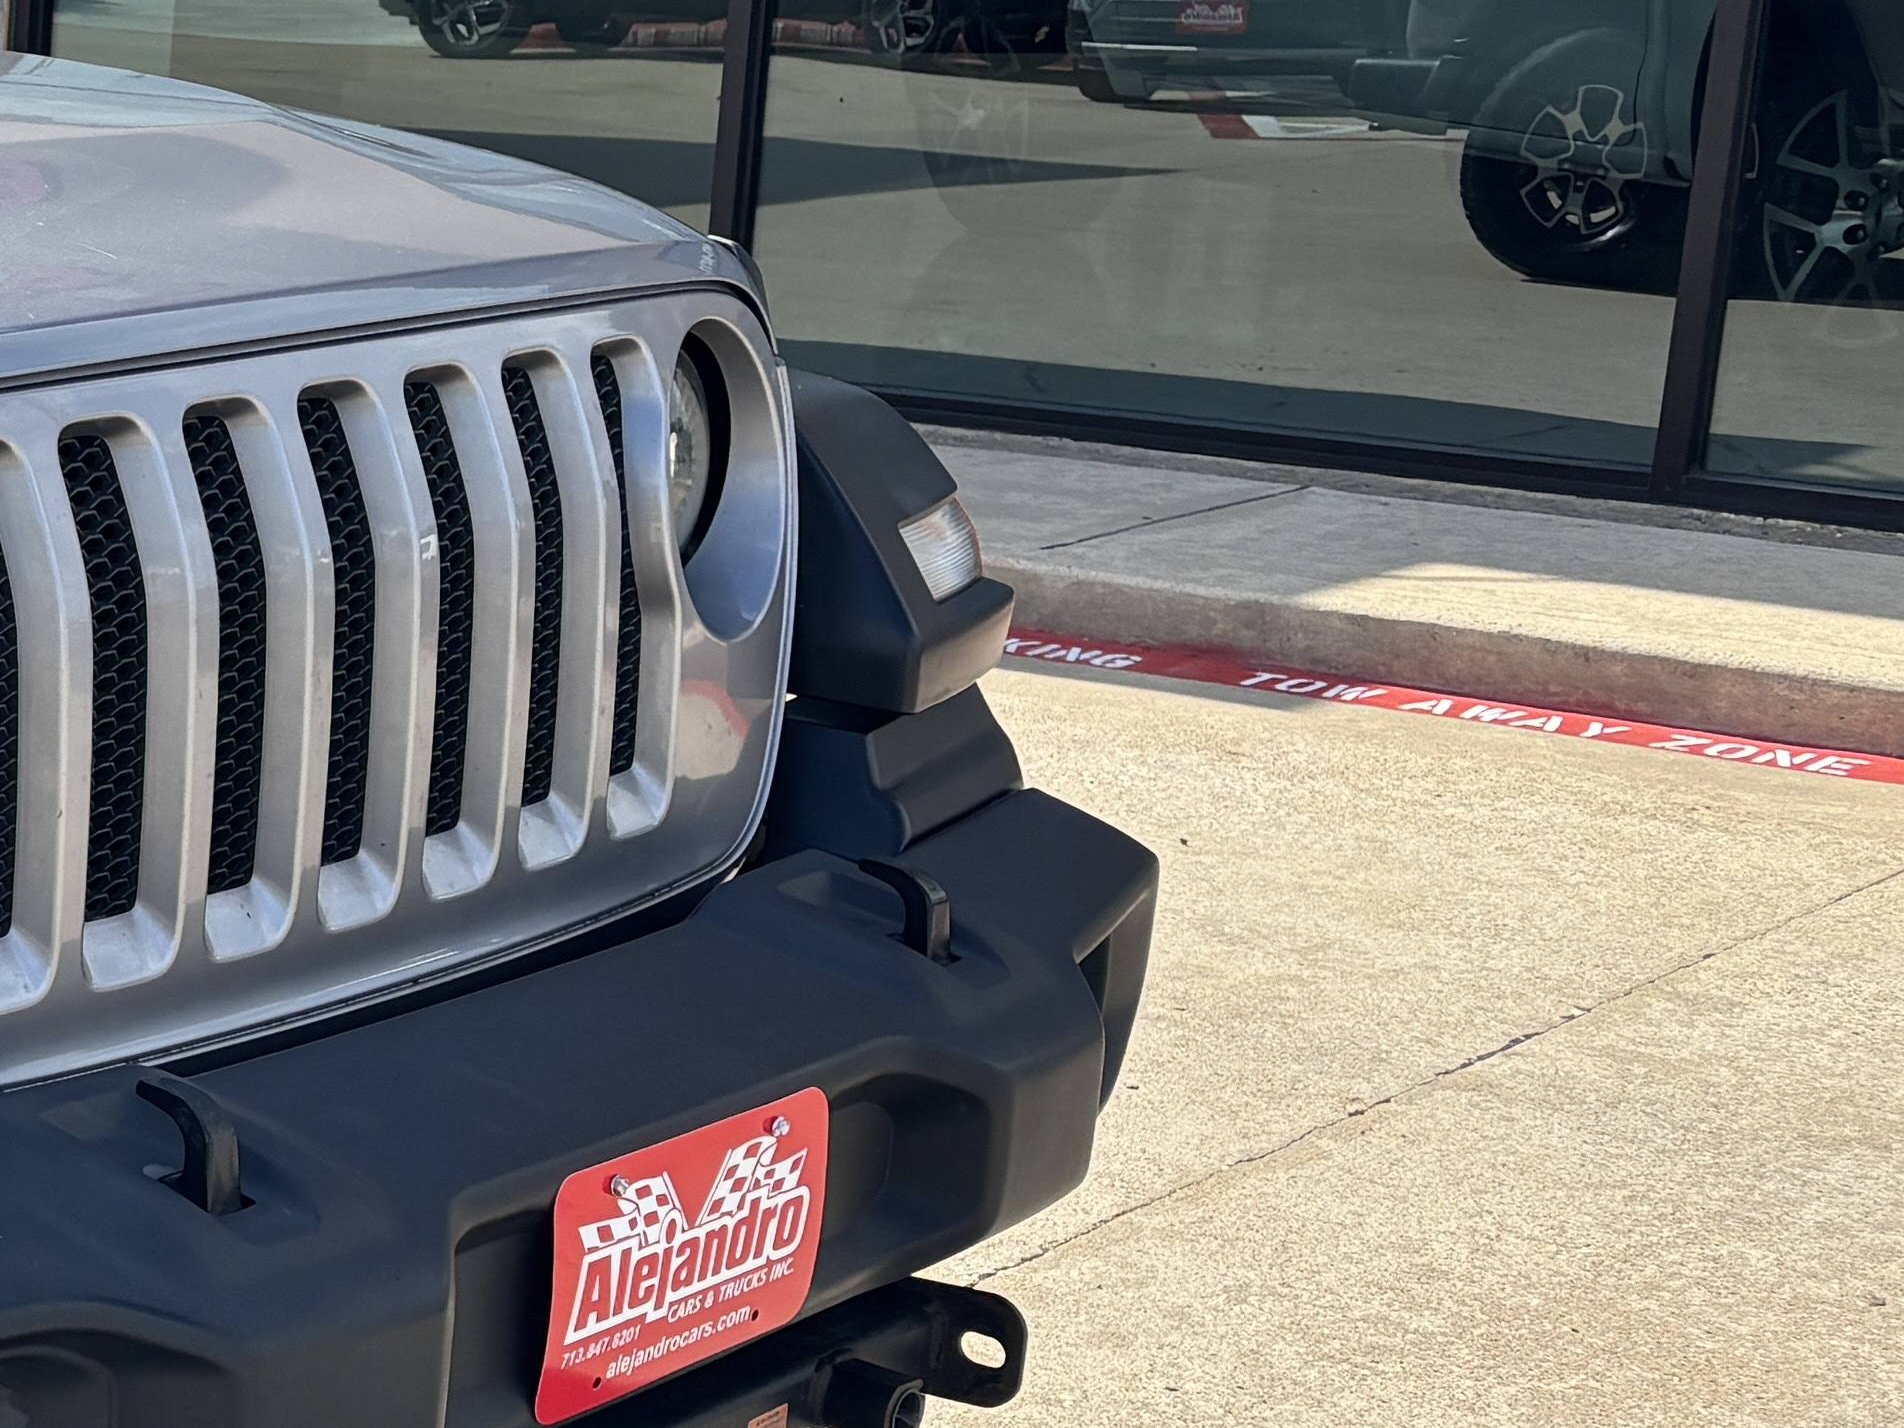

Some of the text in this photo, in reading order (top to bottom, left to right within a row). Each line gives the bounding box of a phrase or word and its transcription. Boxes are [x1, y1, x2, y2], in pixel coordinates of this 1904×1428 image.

[1237, 671, 1874, 778] TOW AWAY ZONE
[570, 1190, 805, 1338] Alejandro
[667, 1295, 702, 1324] CARS
[703, 1290, 715, 1309] &
[718, 1267, 769, 1303] TRUCKS
[606, 1304, 751, 1379] alejandrocars.com
